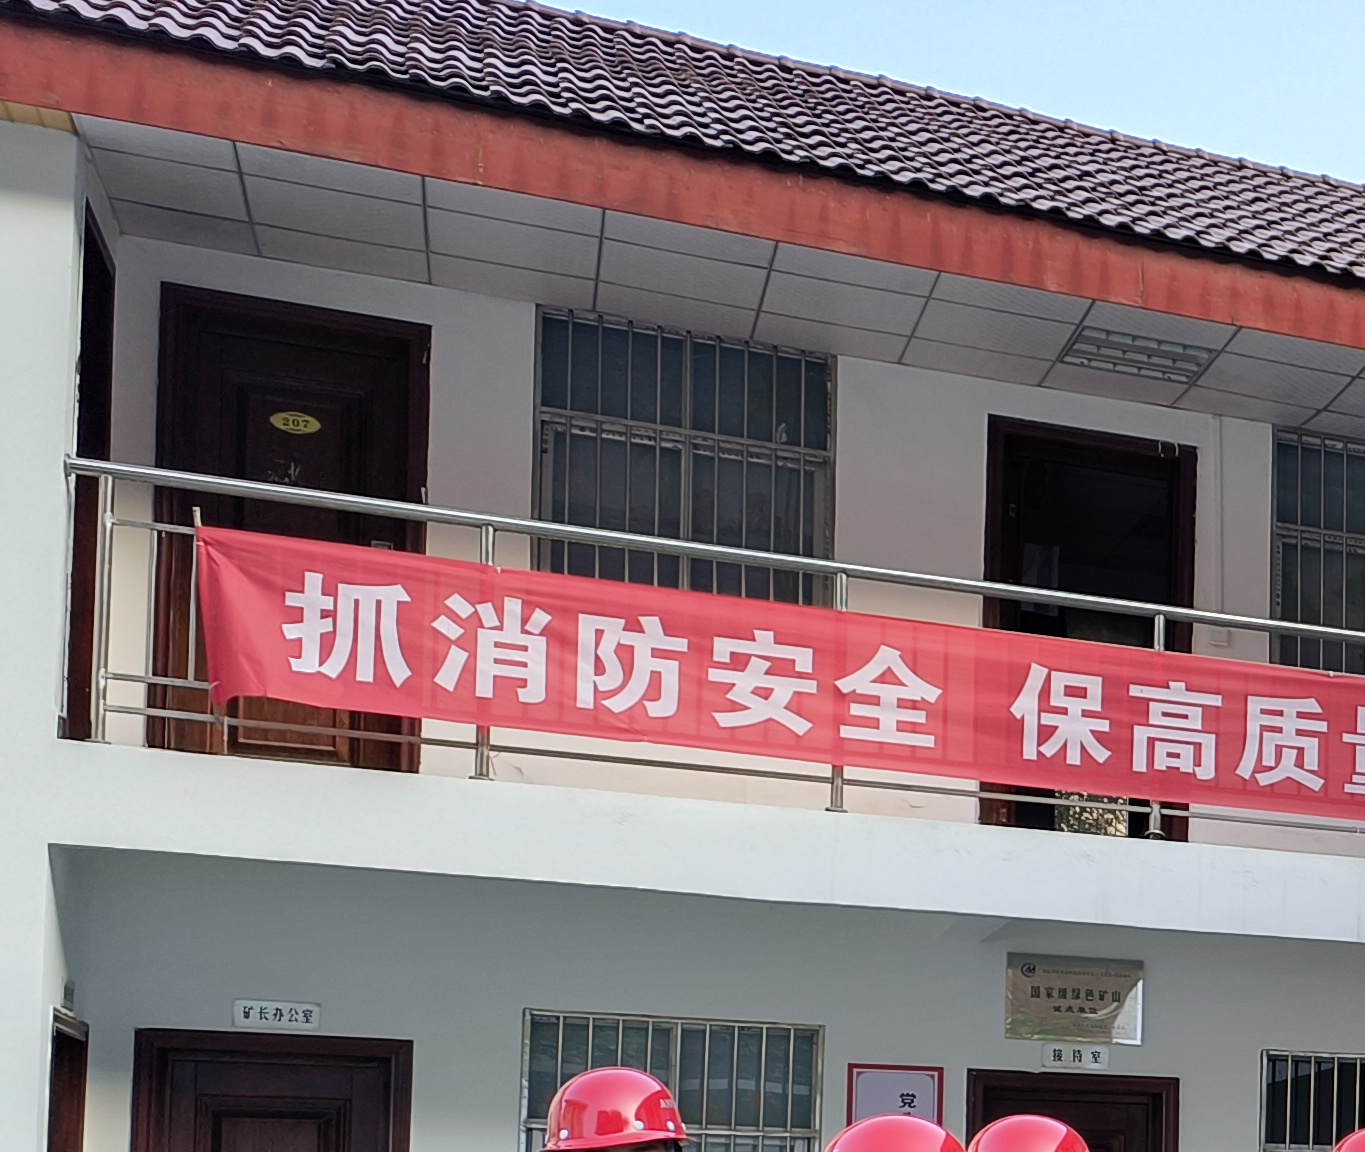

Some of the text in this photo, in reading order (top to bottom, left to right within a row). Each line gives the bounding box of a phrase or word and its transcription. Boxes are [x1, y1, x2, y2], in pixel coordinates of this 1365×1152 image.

[281, 417, 310, 428] 207
[280, 571, 943, 750] 抓消防安全
[242, 1005, 314, 1024] 矿长办公室
[1052, 1048, 1102, 1065] 接待室
